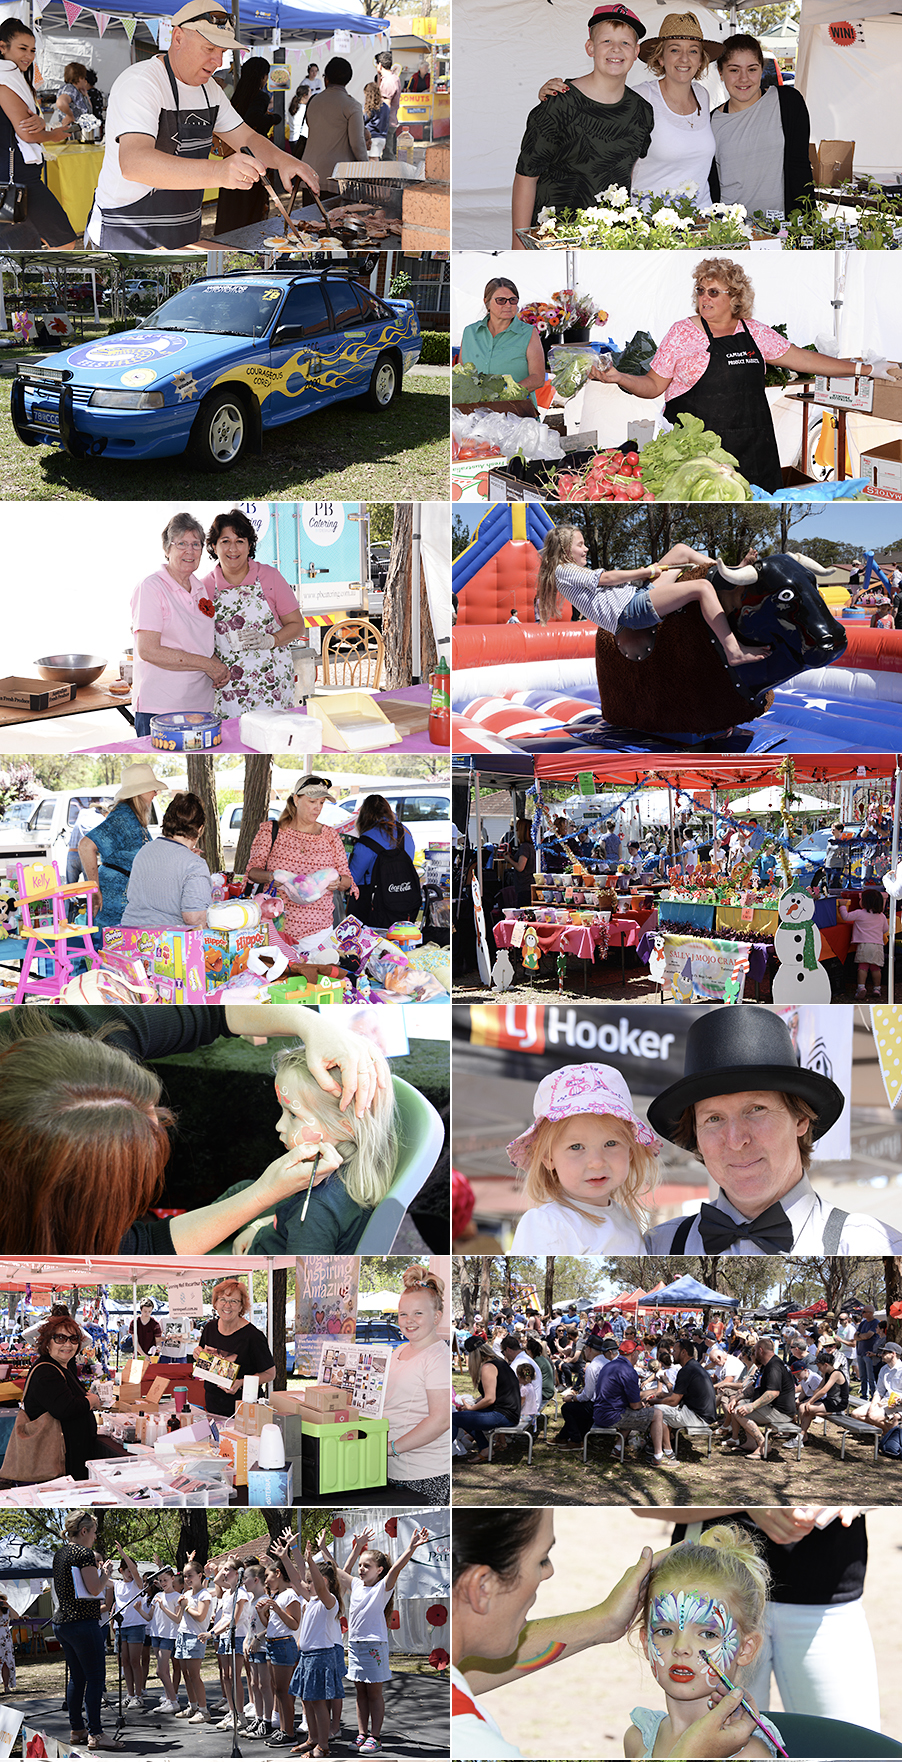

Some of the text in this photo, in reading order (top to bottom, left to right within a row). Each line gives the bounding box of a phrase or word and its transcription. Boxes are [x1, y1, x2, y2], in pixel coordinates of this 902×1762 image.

[830, 26, 855, 39] WIN!
[246, 367, 285, 381] COURAGEOUS
[304, 517, 340, 533] Catering
[33, 873, 51, 890] Kelly
[695, 955, 716, 966] MOJO
[548, 1006, 675, 1060] Hooker
